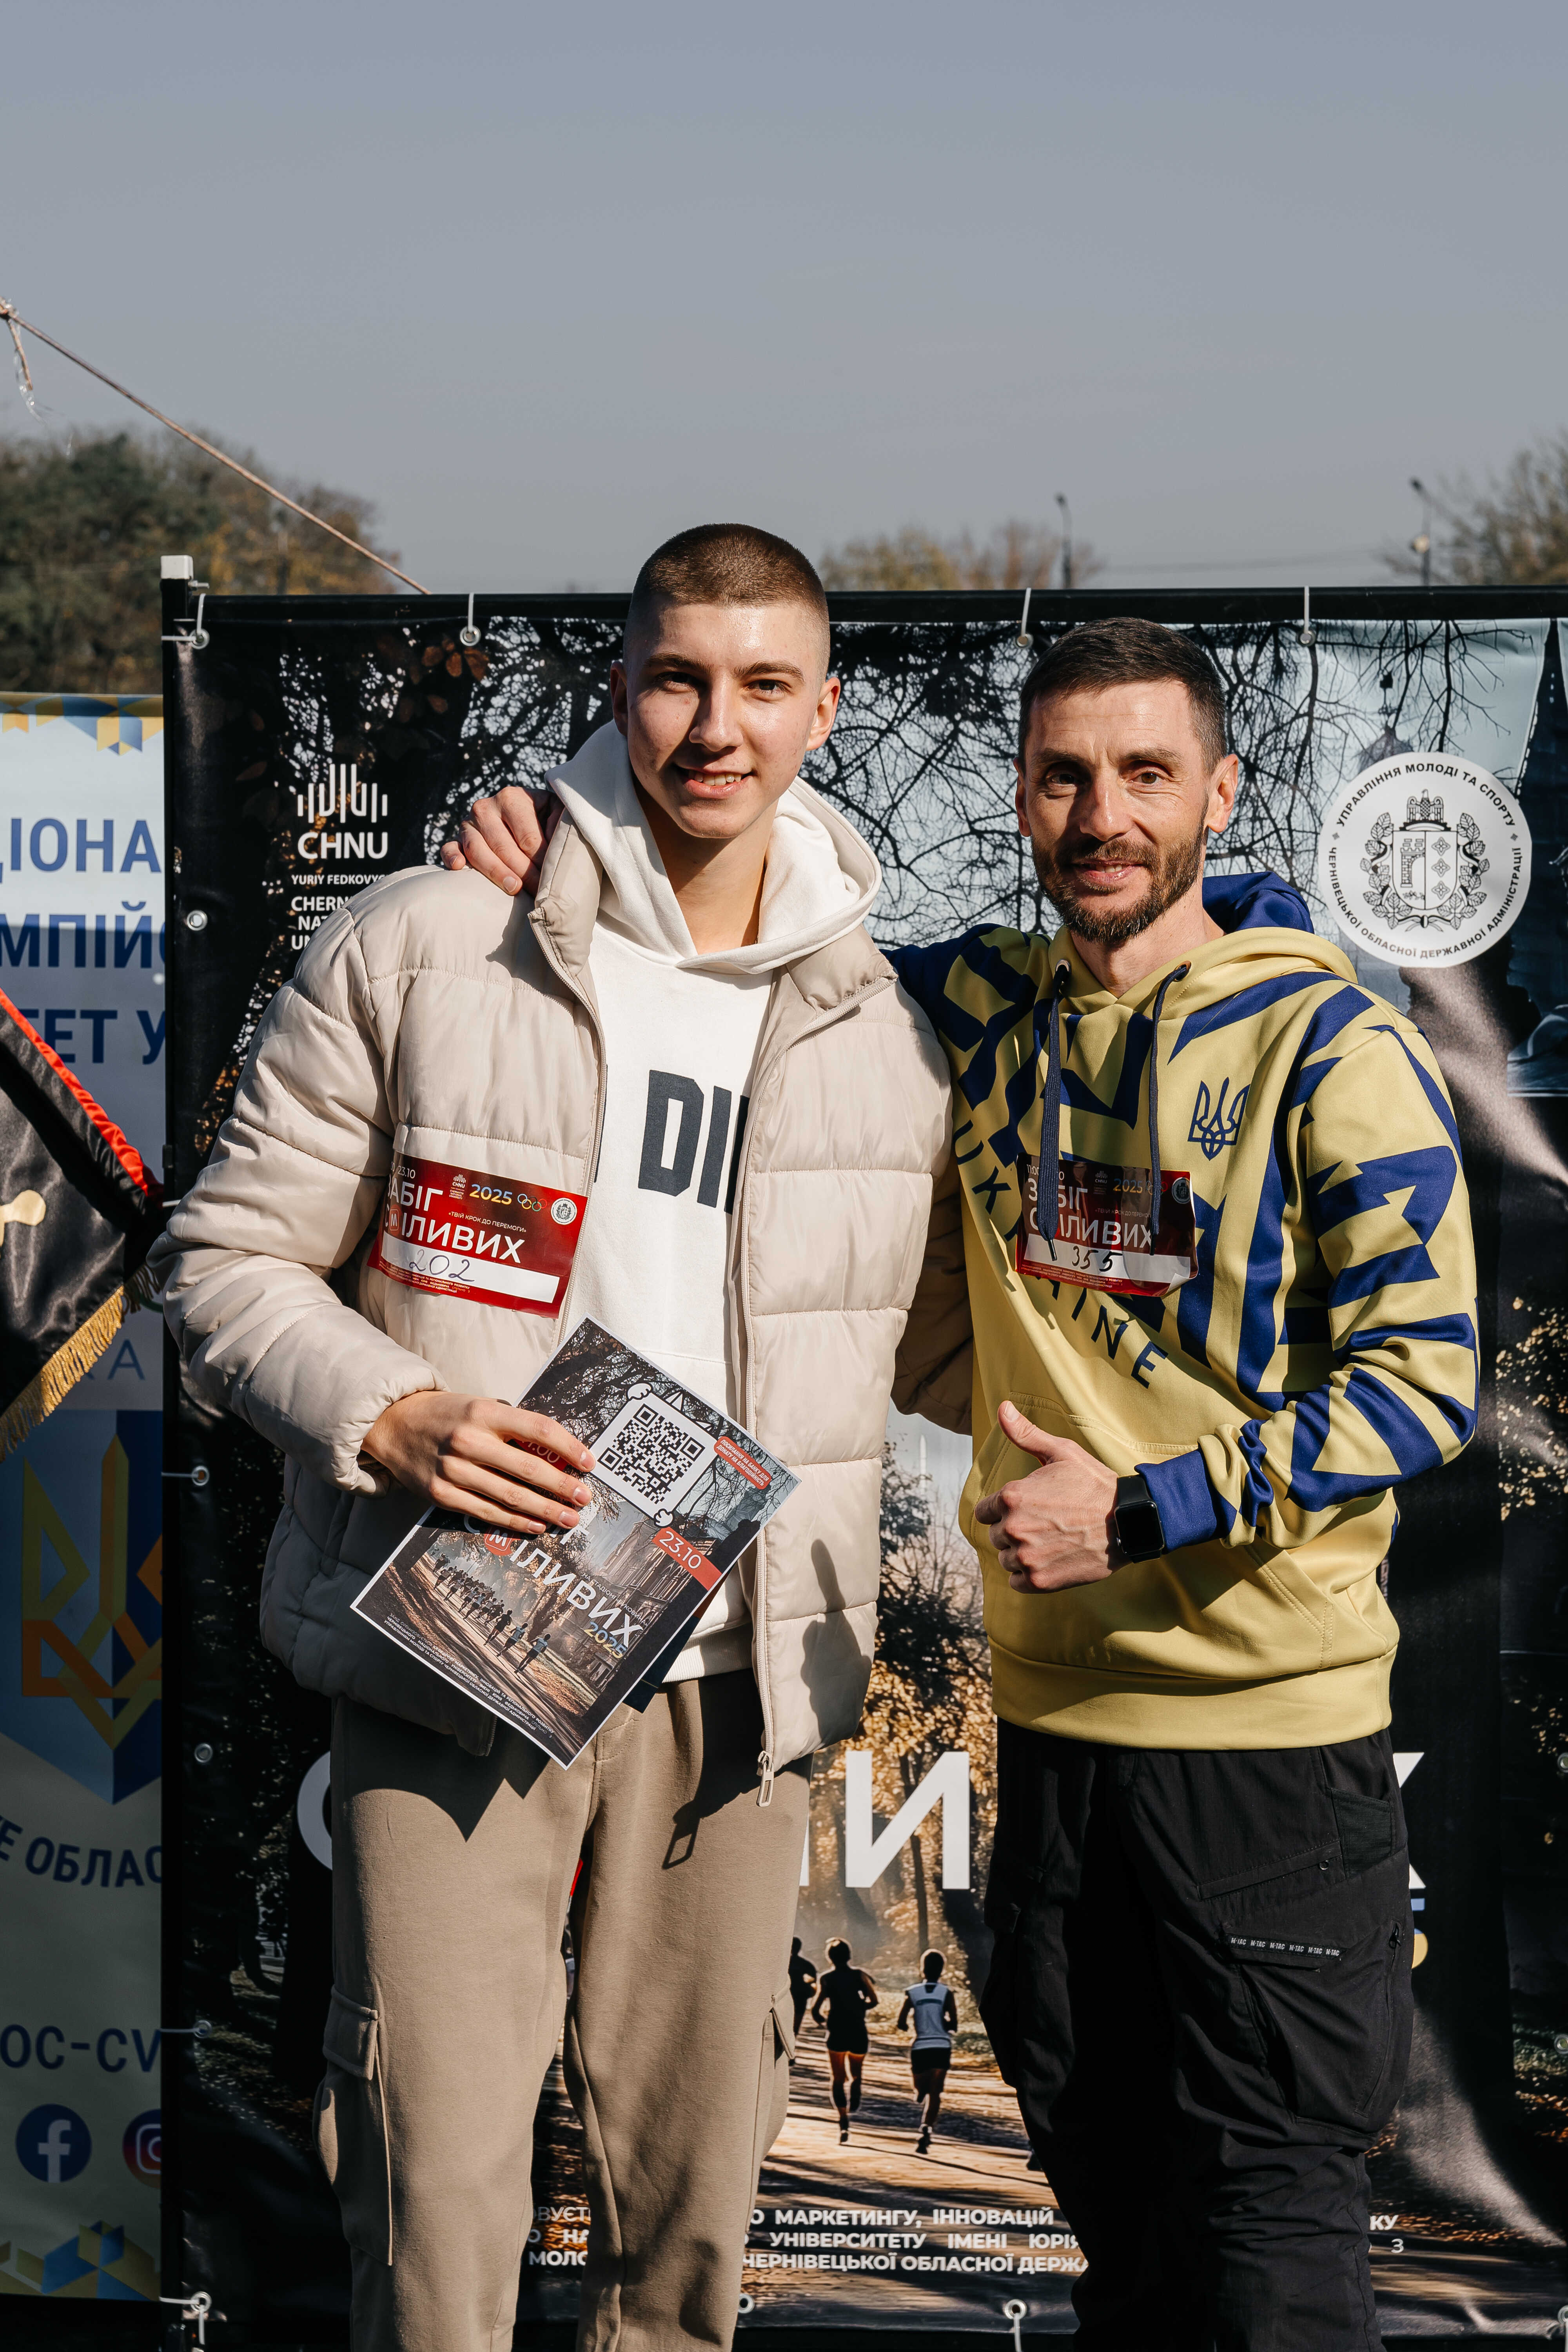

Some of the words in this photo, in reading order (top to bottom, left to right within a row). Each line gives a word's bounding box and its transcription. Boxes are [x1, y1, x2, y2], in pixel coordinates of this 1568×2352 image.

[1337, 767, 1401, 827] УПРАВЛІННЯ
[1405, 763, 1458, 777] МОЛОДІ
[1463, 771, 1477, 786] ТА
[1480, 784, 1515, 826] СПОРТУ
[0, 818, 162, 884] ІОНА
[298, 832, 388, 859] CHNU
[291, 875, 324, 885] YURIY
[327, 875, 389, 885] FEDKOVY
[291, 896, 353, 911] CHERN
[1328, 847, 1363, 928] ЧЕРНІВЕЦЬКОЇ
[1361, 928, 1416, 957] ОБЛАСНОЇ
[1420, 927, 1486, 959] ДЕРЖАВНОЇ
[1487, 847, 1523, 932] АДМІНІСТРАЦІЇ
[0, 901, 165, 969] МПІЙ
[398, 1165, 416, 1178] 23.10
[1113, 1178, 1143, 1193] 2025
[469, 1184, 513, 1205] 2025
[1028, 1178, 1088, 1210] ЗБІГ
[492, 1221, 526, 1232] ПЕРЕМОГИ»
[409, 1249, 475, 1282] 202
[953, 1120, 1169, 1389] UKINE
[1072, 1245, 1123, 1272] 355
[717, 1444, 732, 1458] ДОНАТУ
[736, 1461, 764, 1486] БЛАГОДІЙНІСТЬ
[721, 1439, 744, 1459] ПОСИЛАННЯ
[748, 1462, 760, 1474] БАНКУ
[759, 1472, 769, 1482] ДЛЯ
[659, 1531, 701, 1569] 23.10
[581, 1572, 592, 1582] НА
[590, 1578, 617, 1600] СТАДІОНІ
[584, 1621, 627, 1659] 2025
[384, 1620, 409, 1640] УПРАВЛІННЯМ
[410, 1639, 424, 1651] МОЛОДІ
[430, 1654, 443, 1665] СПОРТУ
[444, 1663, 470, 1683] ЧЕРНІВЕЦЬКОЇ
[470, 1682, 488, 1696] ОБЛАСНОЇ
[488, 1695, 509, 1711] ДЕРЖАВНОЇ
[510, 1710, 535, 1730] АДМІНІСТРАЦІЇ
[387, 1617, 415, 1639] ЧЕРНІВЕЦЬКОГО
[419, 1640, 448, 1663] НАЦІОНАЛЬНОГО
[451, 1663, 477, 1683] УНІВЕРСИТЕТУ
[480, 1683, 490, 1692] ІМЕНІ
[493, 1693, 502, 1701] ЮРІЯ
[505, 1701, 528, 1720] ФЕДЬКОВИЧА
[434, 1645, 453, 1661] КАФЕДРОЮ
[481, 1679, 500, 1693] ІННОВАЦІЙ
[507, 1697, 535, 1719] РЕГІОНАЛЬНОГО
[536, 1719, 554, 1733] РОЗВИТКУ
[775, 2209, 922, 2229] МАРКЕТИНГУ,
[933, 2207, 1054, 2227] ІННОВАЦІЙ
[769, 2232, 927, 2249] УНІВЕРСИТЕТУ
[947, 2233, 1007, 2249] ІМЕНІ
[1391, 2238, 1404, 2253] З
[901, 2253, 1014, 2272] ОБЛАСНОЇ
